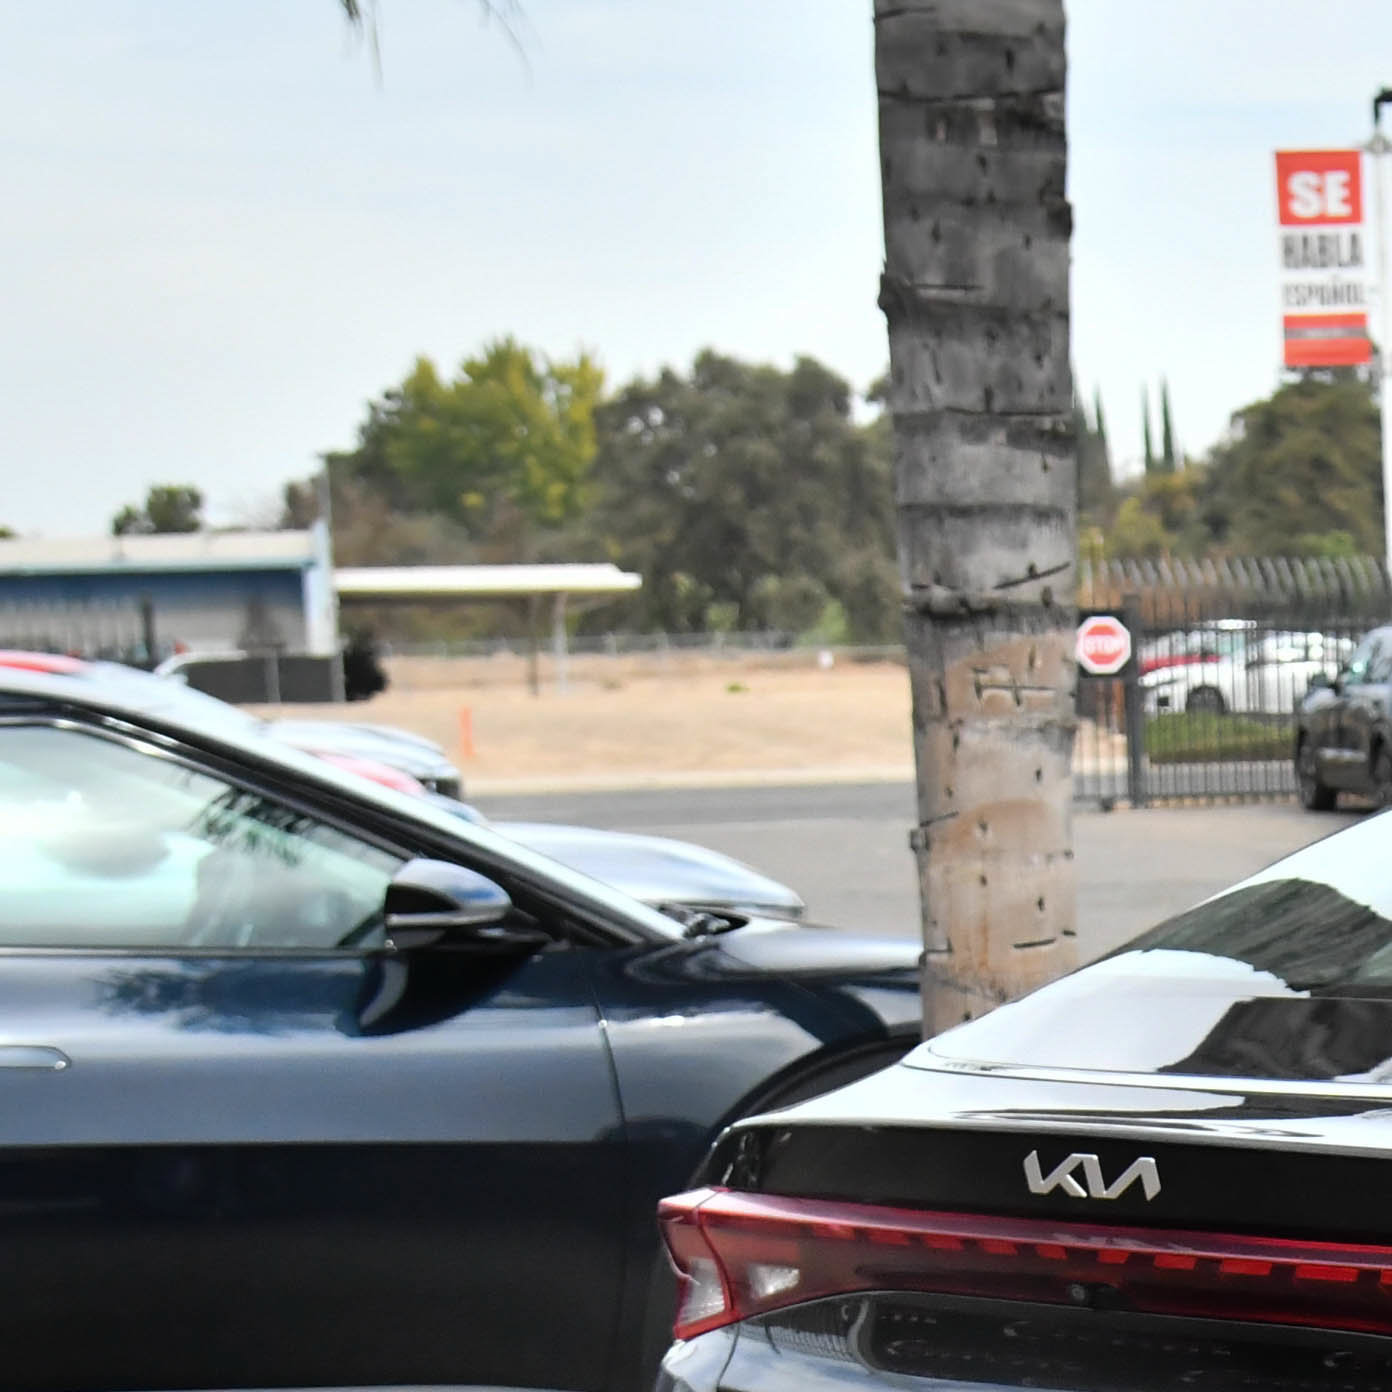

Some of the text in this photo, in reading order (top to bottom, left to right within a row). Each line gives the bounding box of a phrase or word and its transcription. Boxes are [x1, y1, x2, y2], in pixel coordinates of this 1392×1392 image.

[1288, 171, 1351, 217] SE
[1083, 634, 1126, 653] STOP
[1023, 1149, 1162, 1201] KIA
